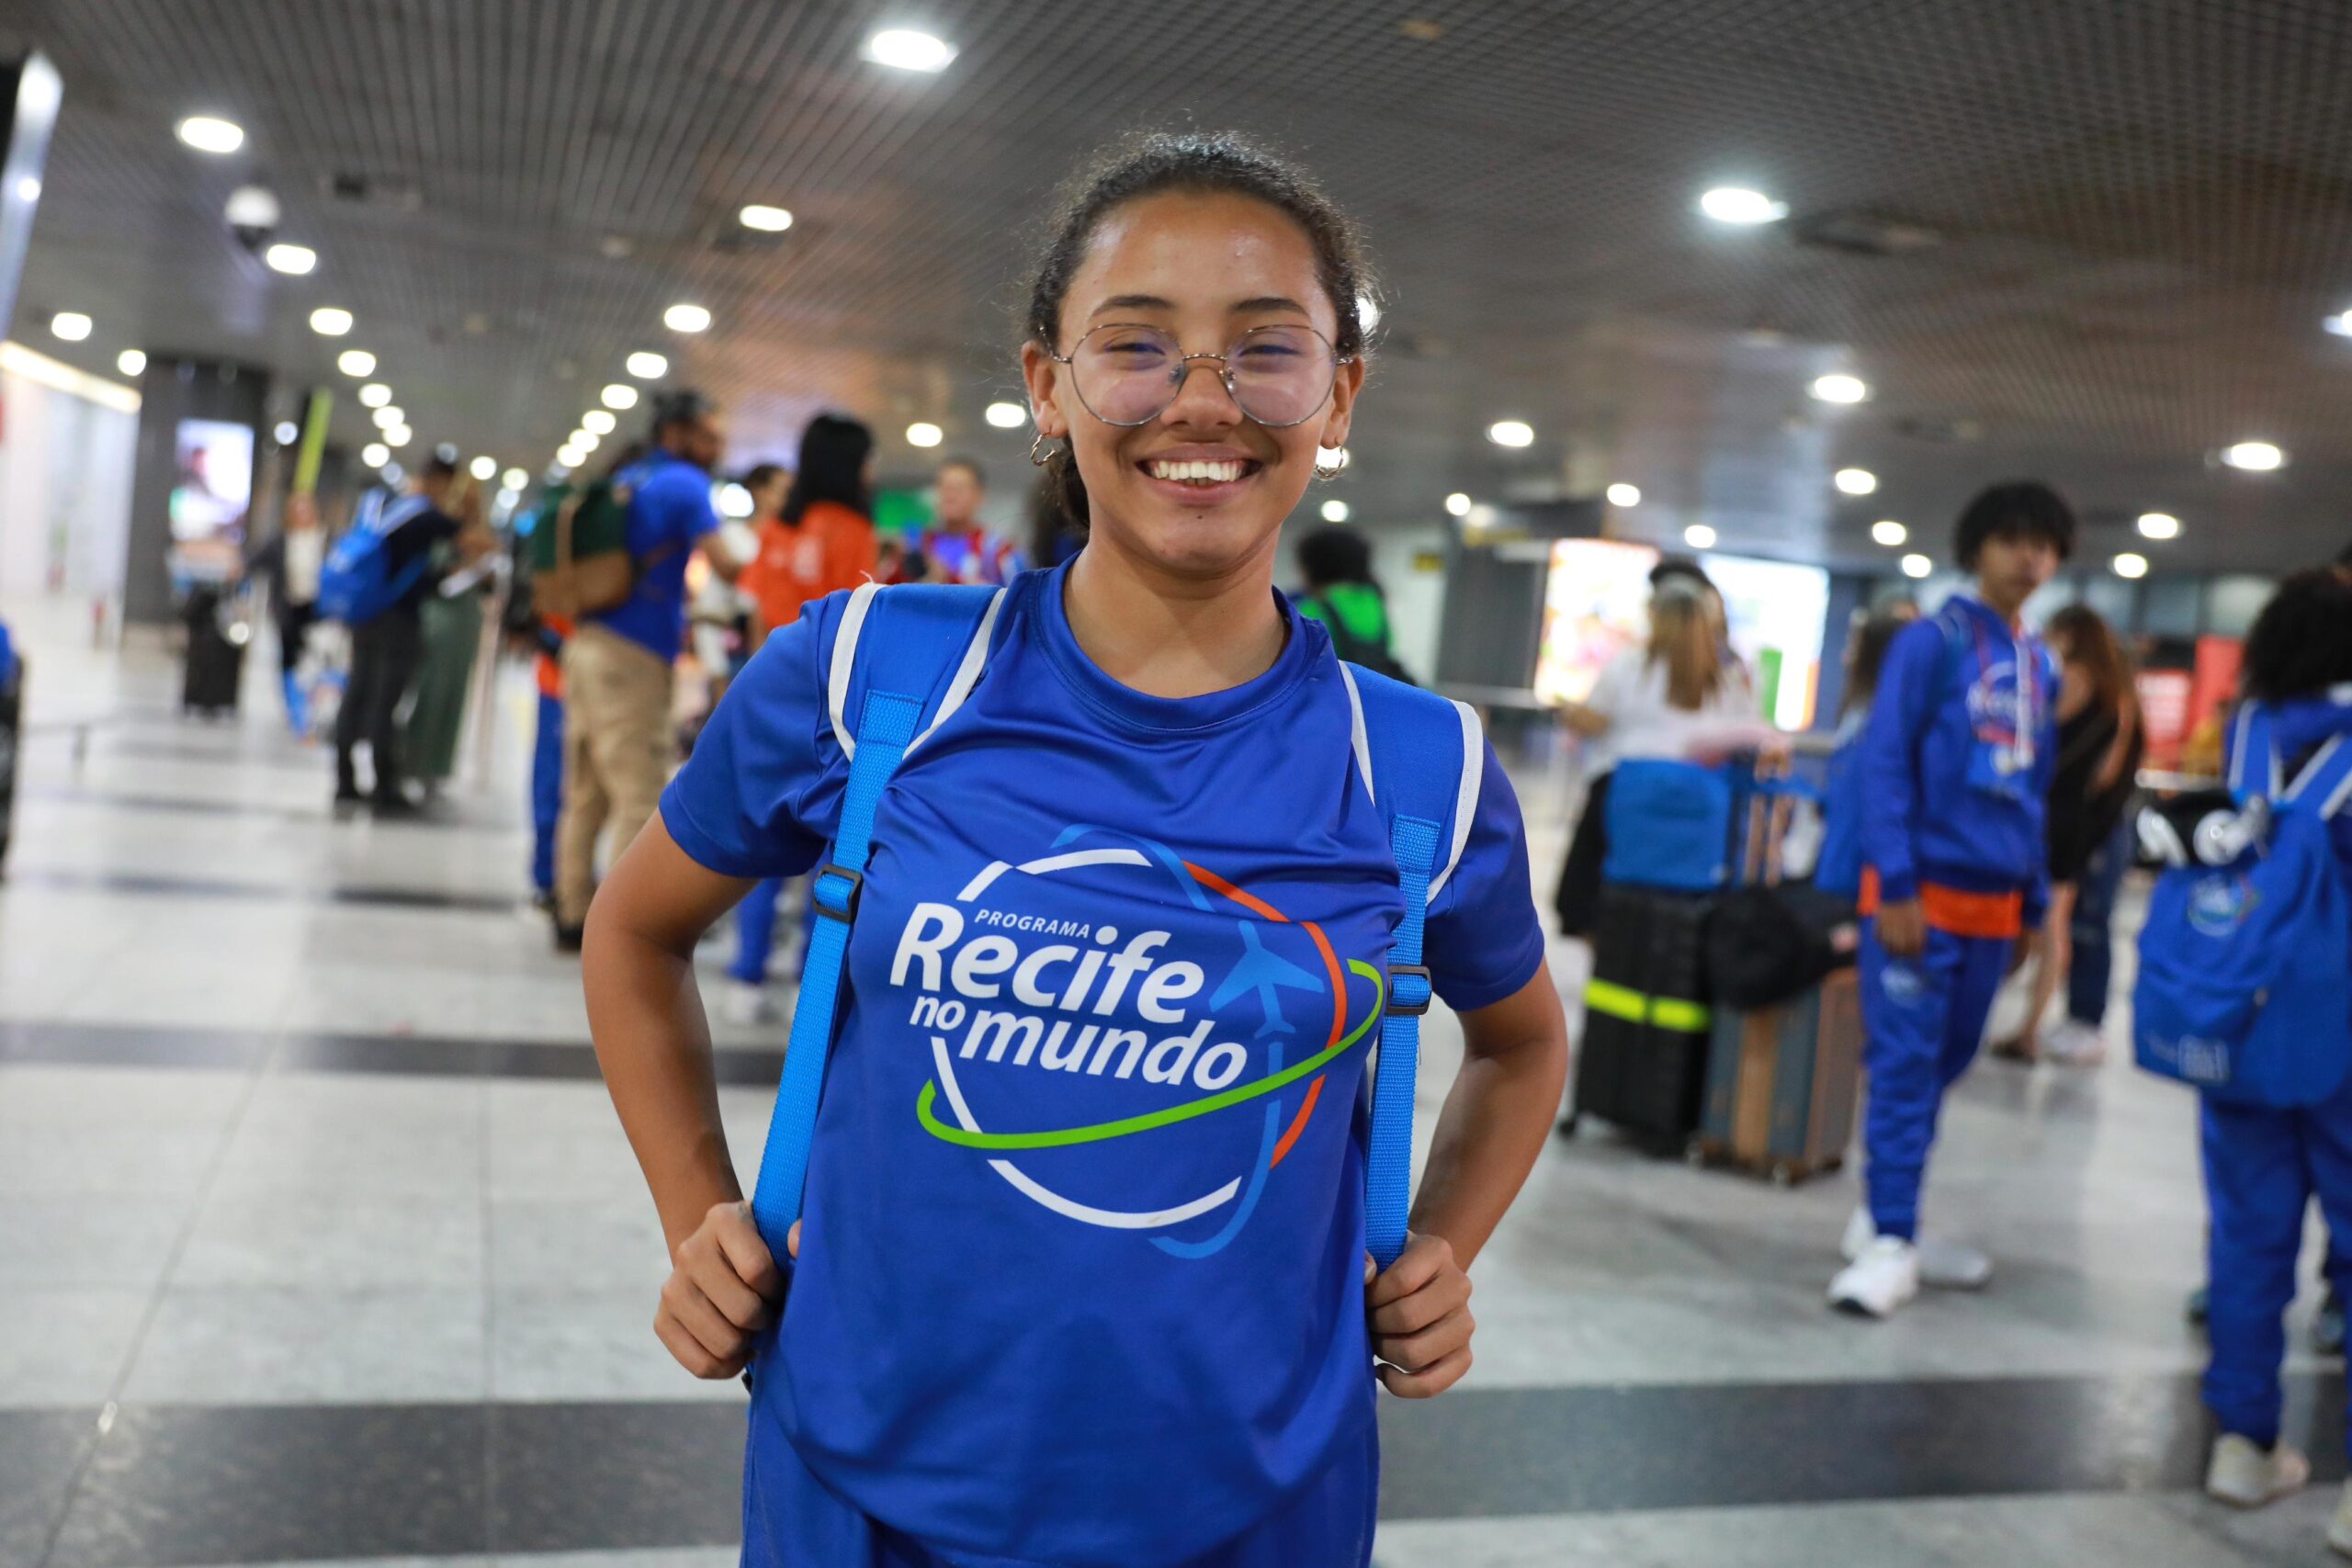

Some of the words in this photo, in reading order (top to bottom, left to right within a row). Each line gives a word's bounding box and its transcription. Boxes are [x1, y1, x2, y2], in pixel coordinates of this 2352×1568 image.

[889, 902, 1204, 1023] Recife
[975, 909, 1090, 938] PROGRAMA
[910, 996, 966, 1031] no
[959, 1010, 1248, 1090] mundo
